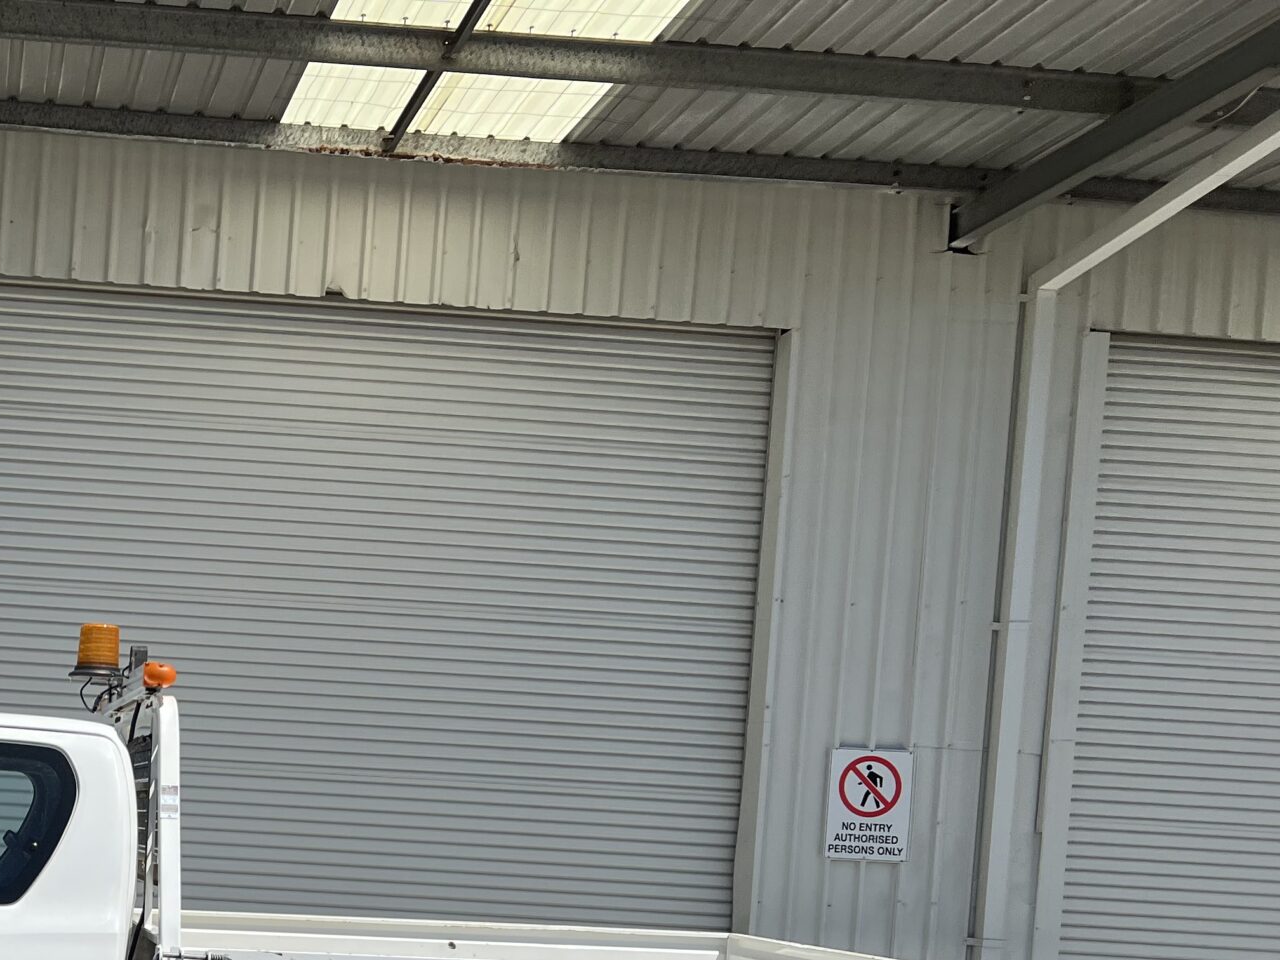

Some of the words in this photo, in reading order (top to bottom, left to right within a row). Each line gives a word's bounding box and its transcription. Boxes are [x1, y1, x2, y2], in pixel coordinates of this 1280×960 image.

[841, 822, 856, 831] NO
[859, 823, 893, 832] ENTRY
[834, 833, 899, 845] AUTHORISED
[828, 844, 875, 855] PERSONS
[877, 847, 904, 857] ONLY
